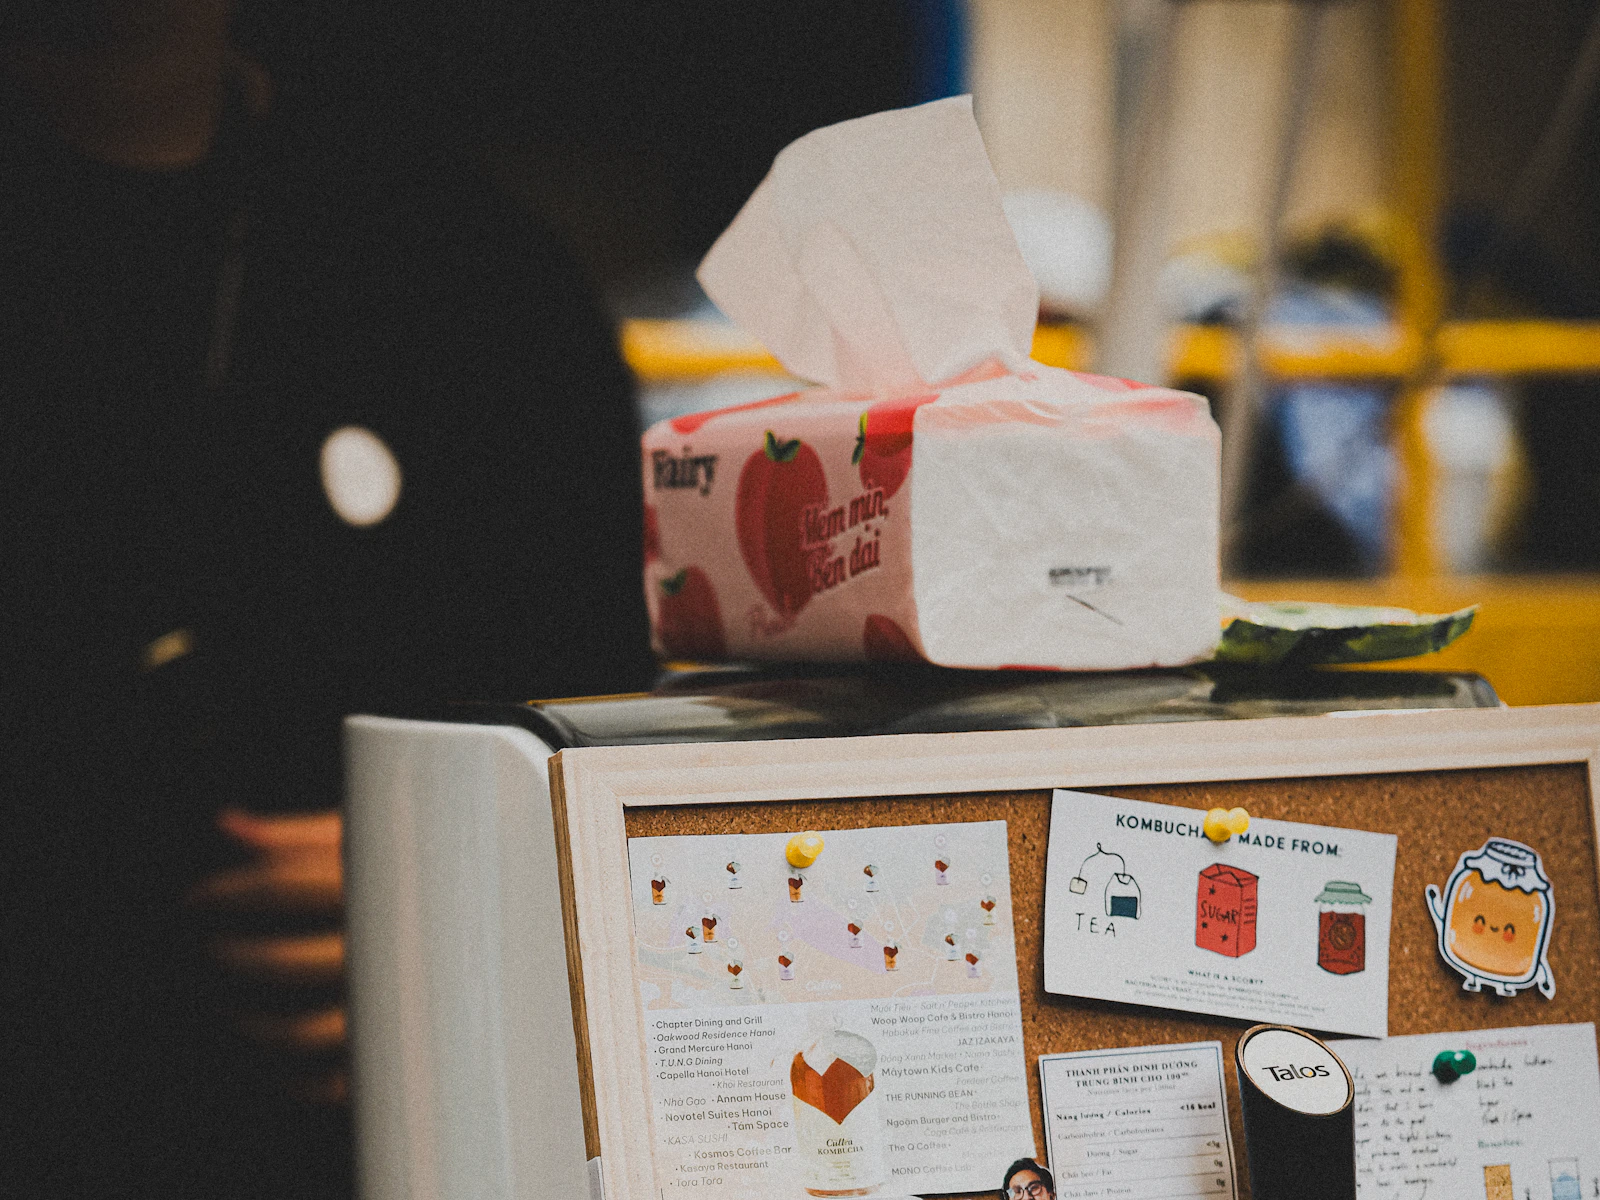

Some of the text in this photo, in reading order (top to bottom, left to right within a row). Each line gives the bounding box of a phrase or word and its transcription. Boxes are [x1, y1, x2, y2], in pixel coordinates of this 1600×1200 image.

[652, 446, 718, 498] Fairy
[1116, 814, 1208, 839] KOMBUCH
[1238, 833, 1285, 850] MADE
[1200, 900, 1241, 925] SUGAR
[1075, 912, 1117, 938] TEA
[656, 1016, 762, 1030] Chapter Dining and Grill
[871, 1017, 897, 1025] Woop
[899, 1015, 925, 1024] Woop
[958, 1012, 986, 1020] Bistro
[987, 1009, 1013, 1018] Hanoi
[656, 1028, 776, 1042] Oakwood Residence Hanoi
[658, 1042, 753, 1055] Grand Mercure Hanoi
[660, 1056, 723, 1067] T.U.N.G Dining
[659, 1067, 749, 1081] Capella Hanoi Hotel
[931, 1064, 953, 1074] Kids
[1261, 1064, 1330, 1082] Talos
[737, 1078, 783, 1088] Restaurant
[716, 1092, 786, 1104] Annam House
[886, 1089, 973, 1102] THE RUNNING BEAN
[665, 1107, 772, 1122] Novotel Suites Hanoi
[920, 1116, 950, 1125] Burger
[951, 1114, 969, 1123] and
[970, 1113, 996, 1122] Bistro
[756, 1120, 789, 1131] Space
[667, 1133, 728, 1145] KASA SUSHI
[694, 1145, 792, 1159] Kosmos Coffee Bar
[889, 1144, 906, 1152] The
[717, 1160, 769, 1171] Restaurant
[891, 1166, 921, 1176] MONO
[676, 1177, 723, 1188] Tora Tora
